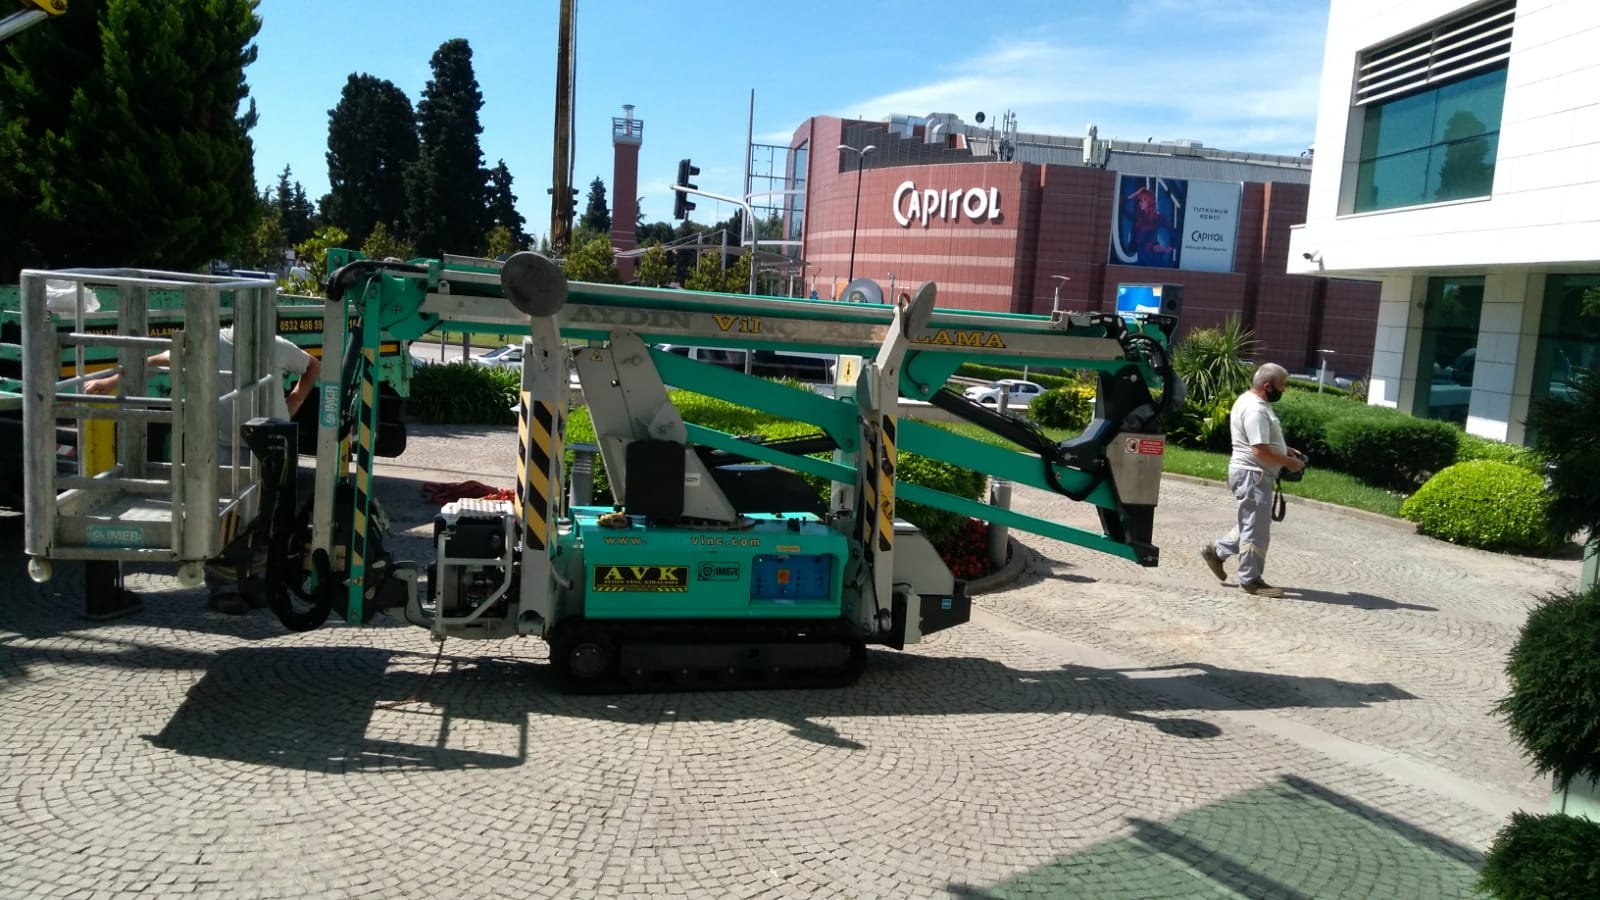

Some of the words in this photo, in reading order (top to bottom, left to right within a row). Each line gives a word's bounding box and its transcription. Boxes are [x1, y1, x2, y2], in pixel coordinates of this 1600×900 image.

[893, 181, 1001, 227] CAPITOL
[1191, 230, 1224, 242] CAPITOL
[280, 320, 298, 331] 0532
[715, 567, 739, 576] IMER
